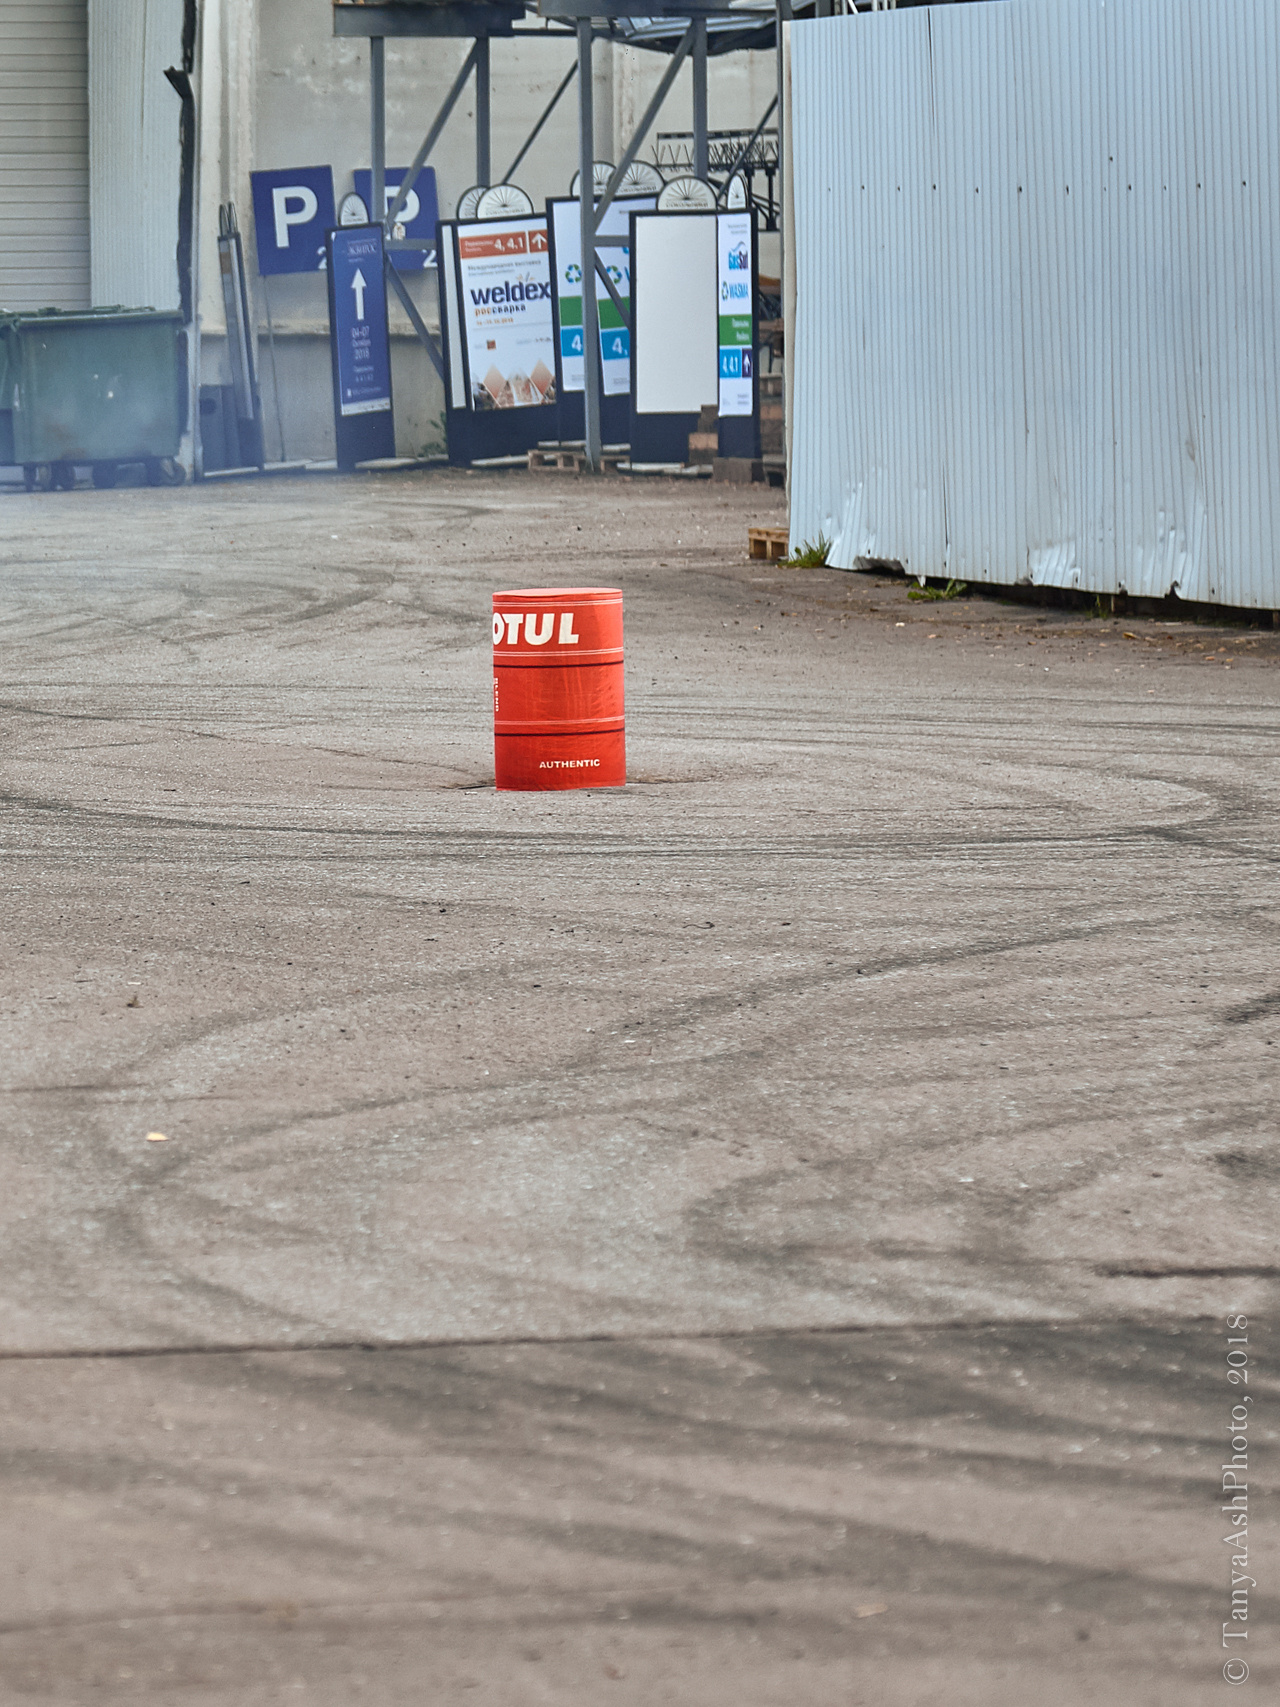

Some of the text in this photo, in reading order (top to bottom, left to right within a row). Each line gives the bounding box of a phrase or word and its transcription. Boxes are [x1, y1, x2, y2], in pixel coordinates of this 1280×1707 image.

[272, 185, 319, 249] P
[470, 280, 552, 306] weldex
[474, 303, 526, 317] россварка
[493, 612, 579, 646] OTUL
[539, 758, 601, 769] AUTHENTIC
